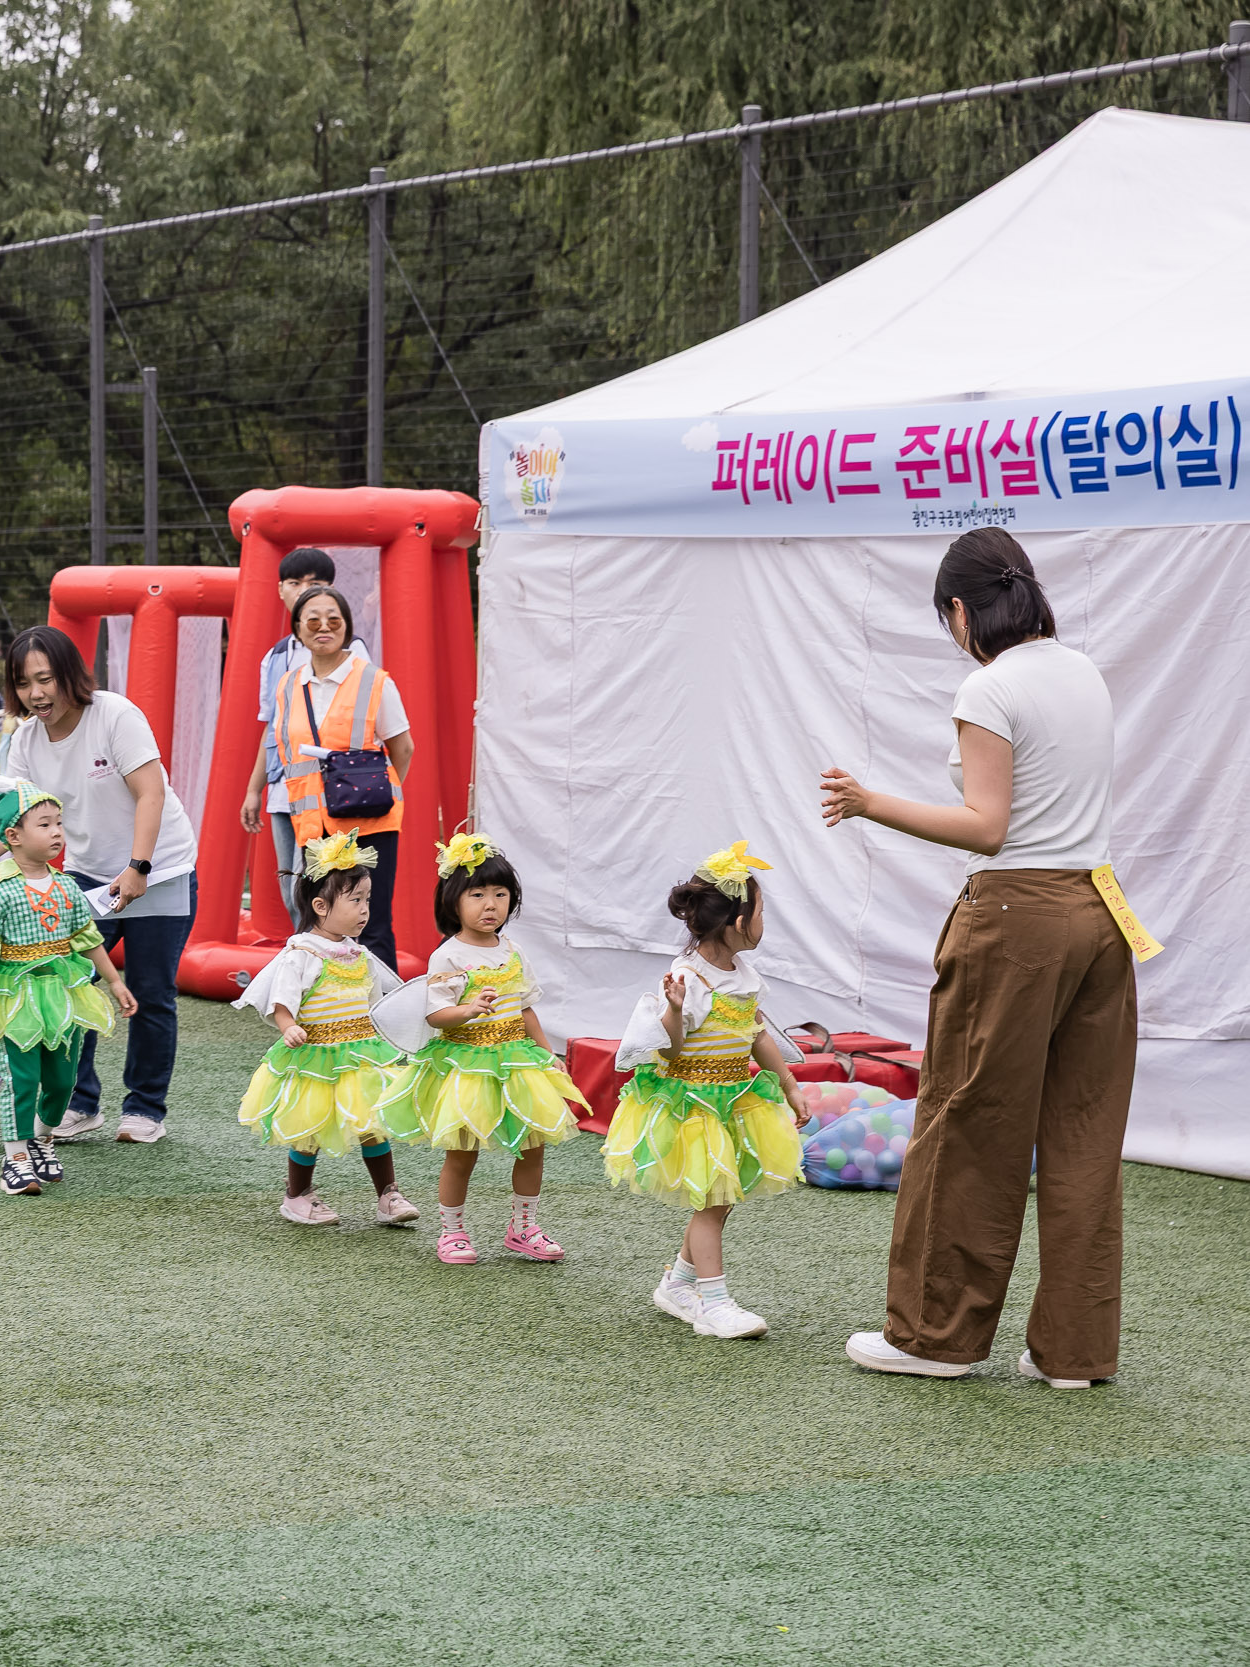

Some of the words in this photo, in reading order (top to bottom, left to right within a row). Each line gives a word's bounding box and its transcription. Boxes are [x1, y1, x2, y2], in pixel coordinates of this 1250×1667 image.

[711, 428, 882, 505] 퍼레이드
[895, 396, 1242, 500] 준비실(탈의실)
[1097, 872, 1151, 955] 안전요원
